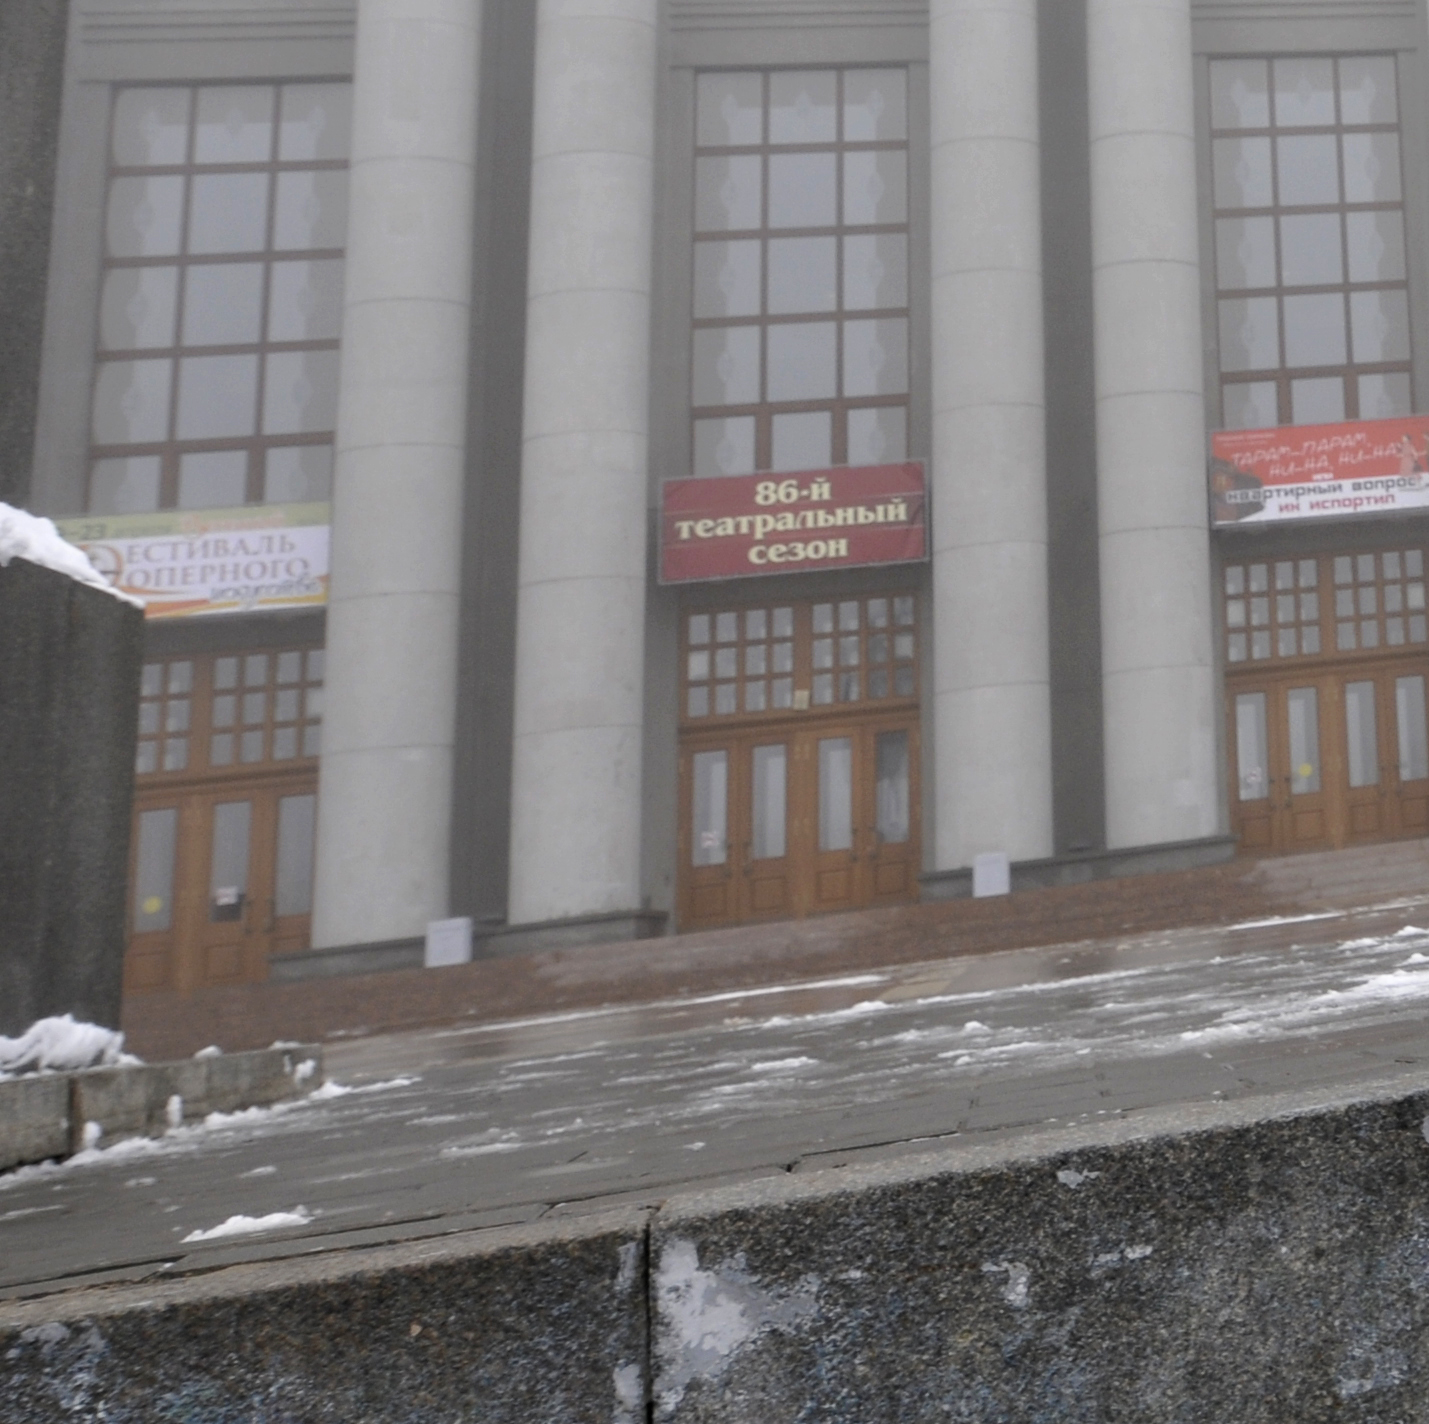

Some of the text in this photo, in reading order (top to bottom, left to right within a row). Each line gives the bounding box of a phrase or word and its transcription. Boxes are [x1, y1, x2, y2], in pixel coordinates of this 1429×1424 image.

[754, 476, 831, 506] 86-й
[674, 498, 908, 541] театральный
[747, 538, 849, 565] сезон
[127, 557, 310, 589] ОПЕРНОГО
